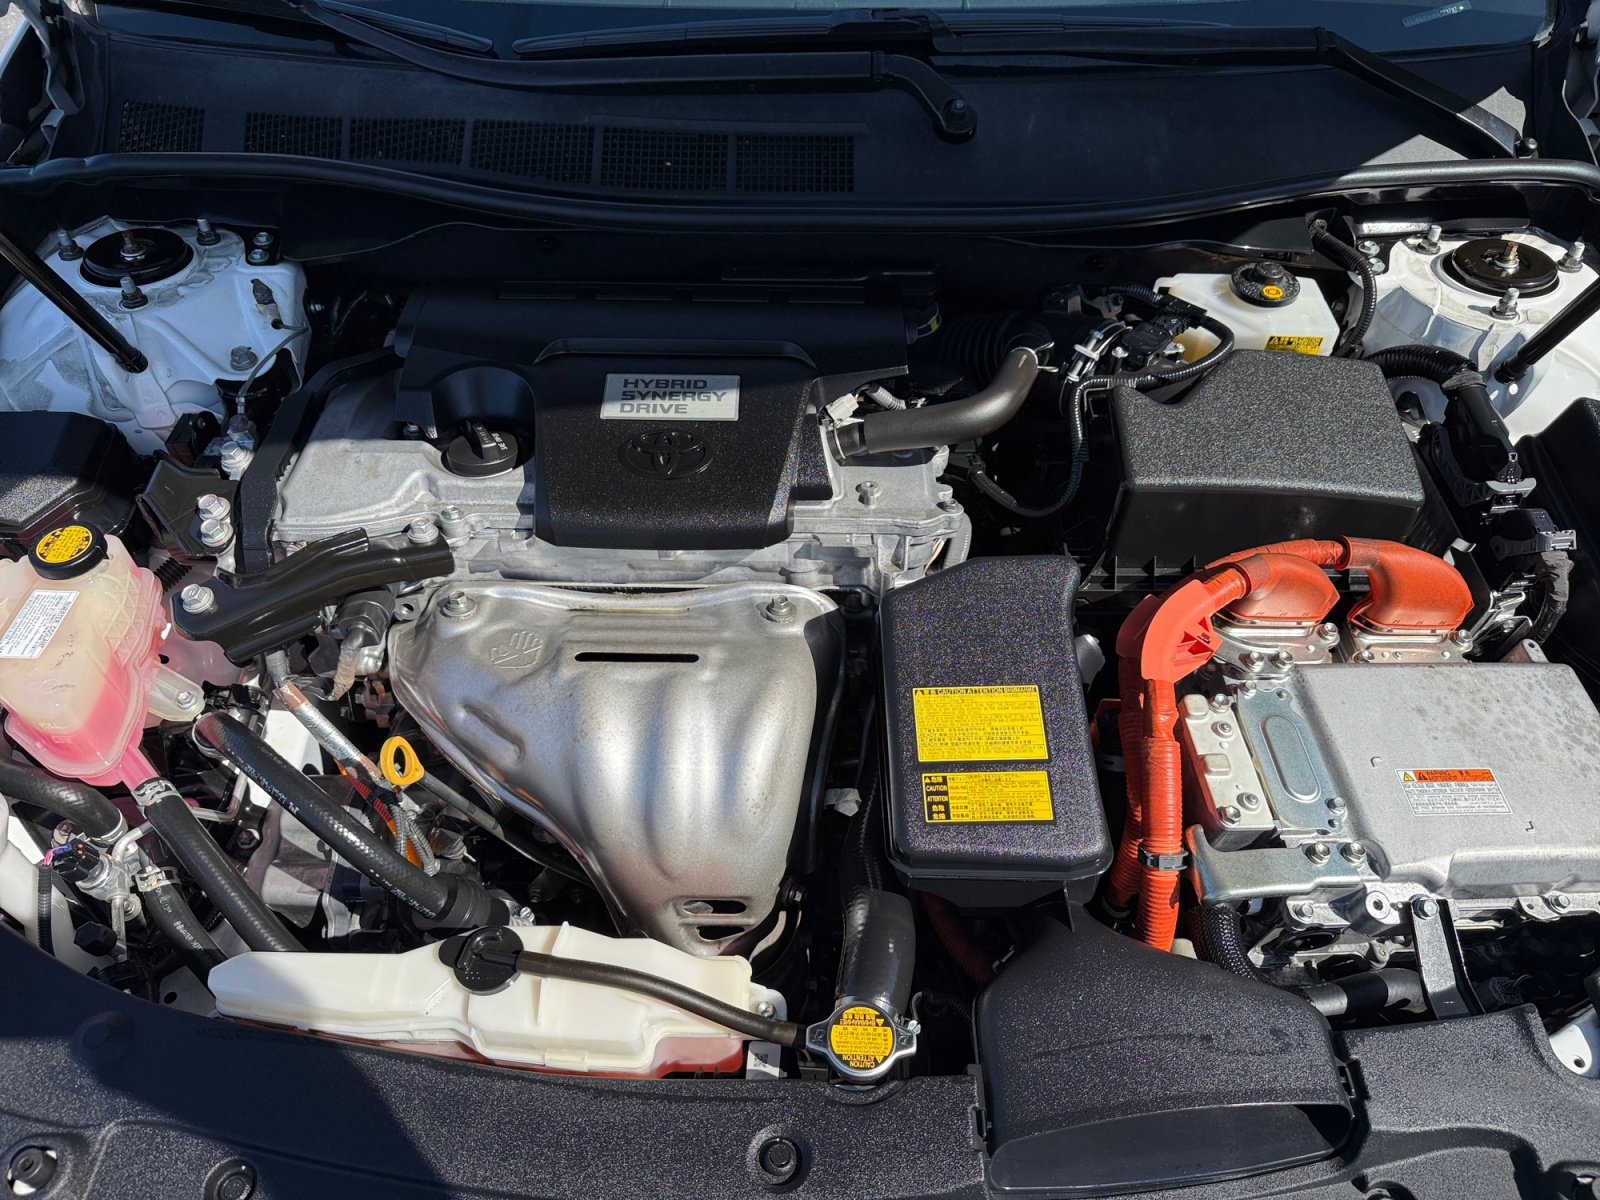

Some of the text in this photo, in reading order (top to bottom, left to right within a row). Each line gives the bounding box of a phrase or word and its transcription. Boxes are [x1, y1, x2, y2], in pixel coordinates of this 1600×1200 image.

[623, 378, 708, 389] HYBRID
[621, 390, 727, 402] SYNERGY
[619, 403, 688, 414] DRIVE
